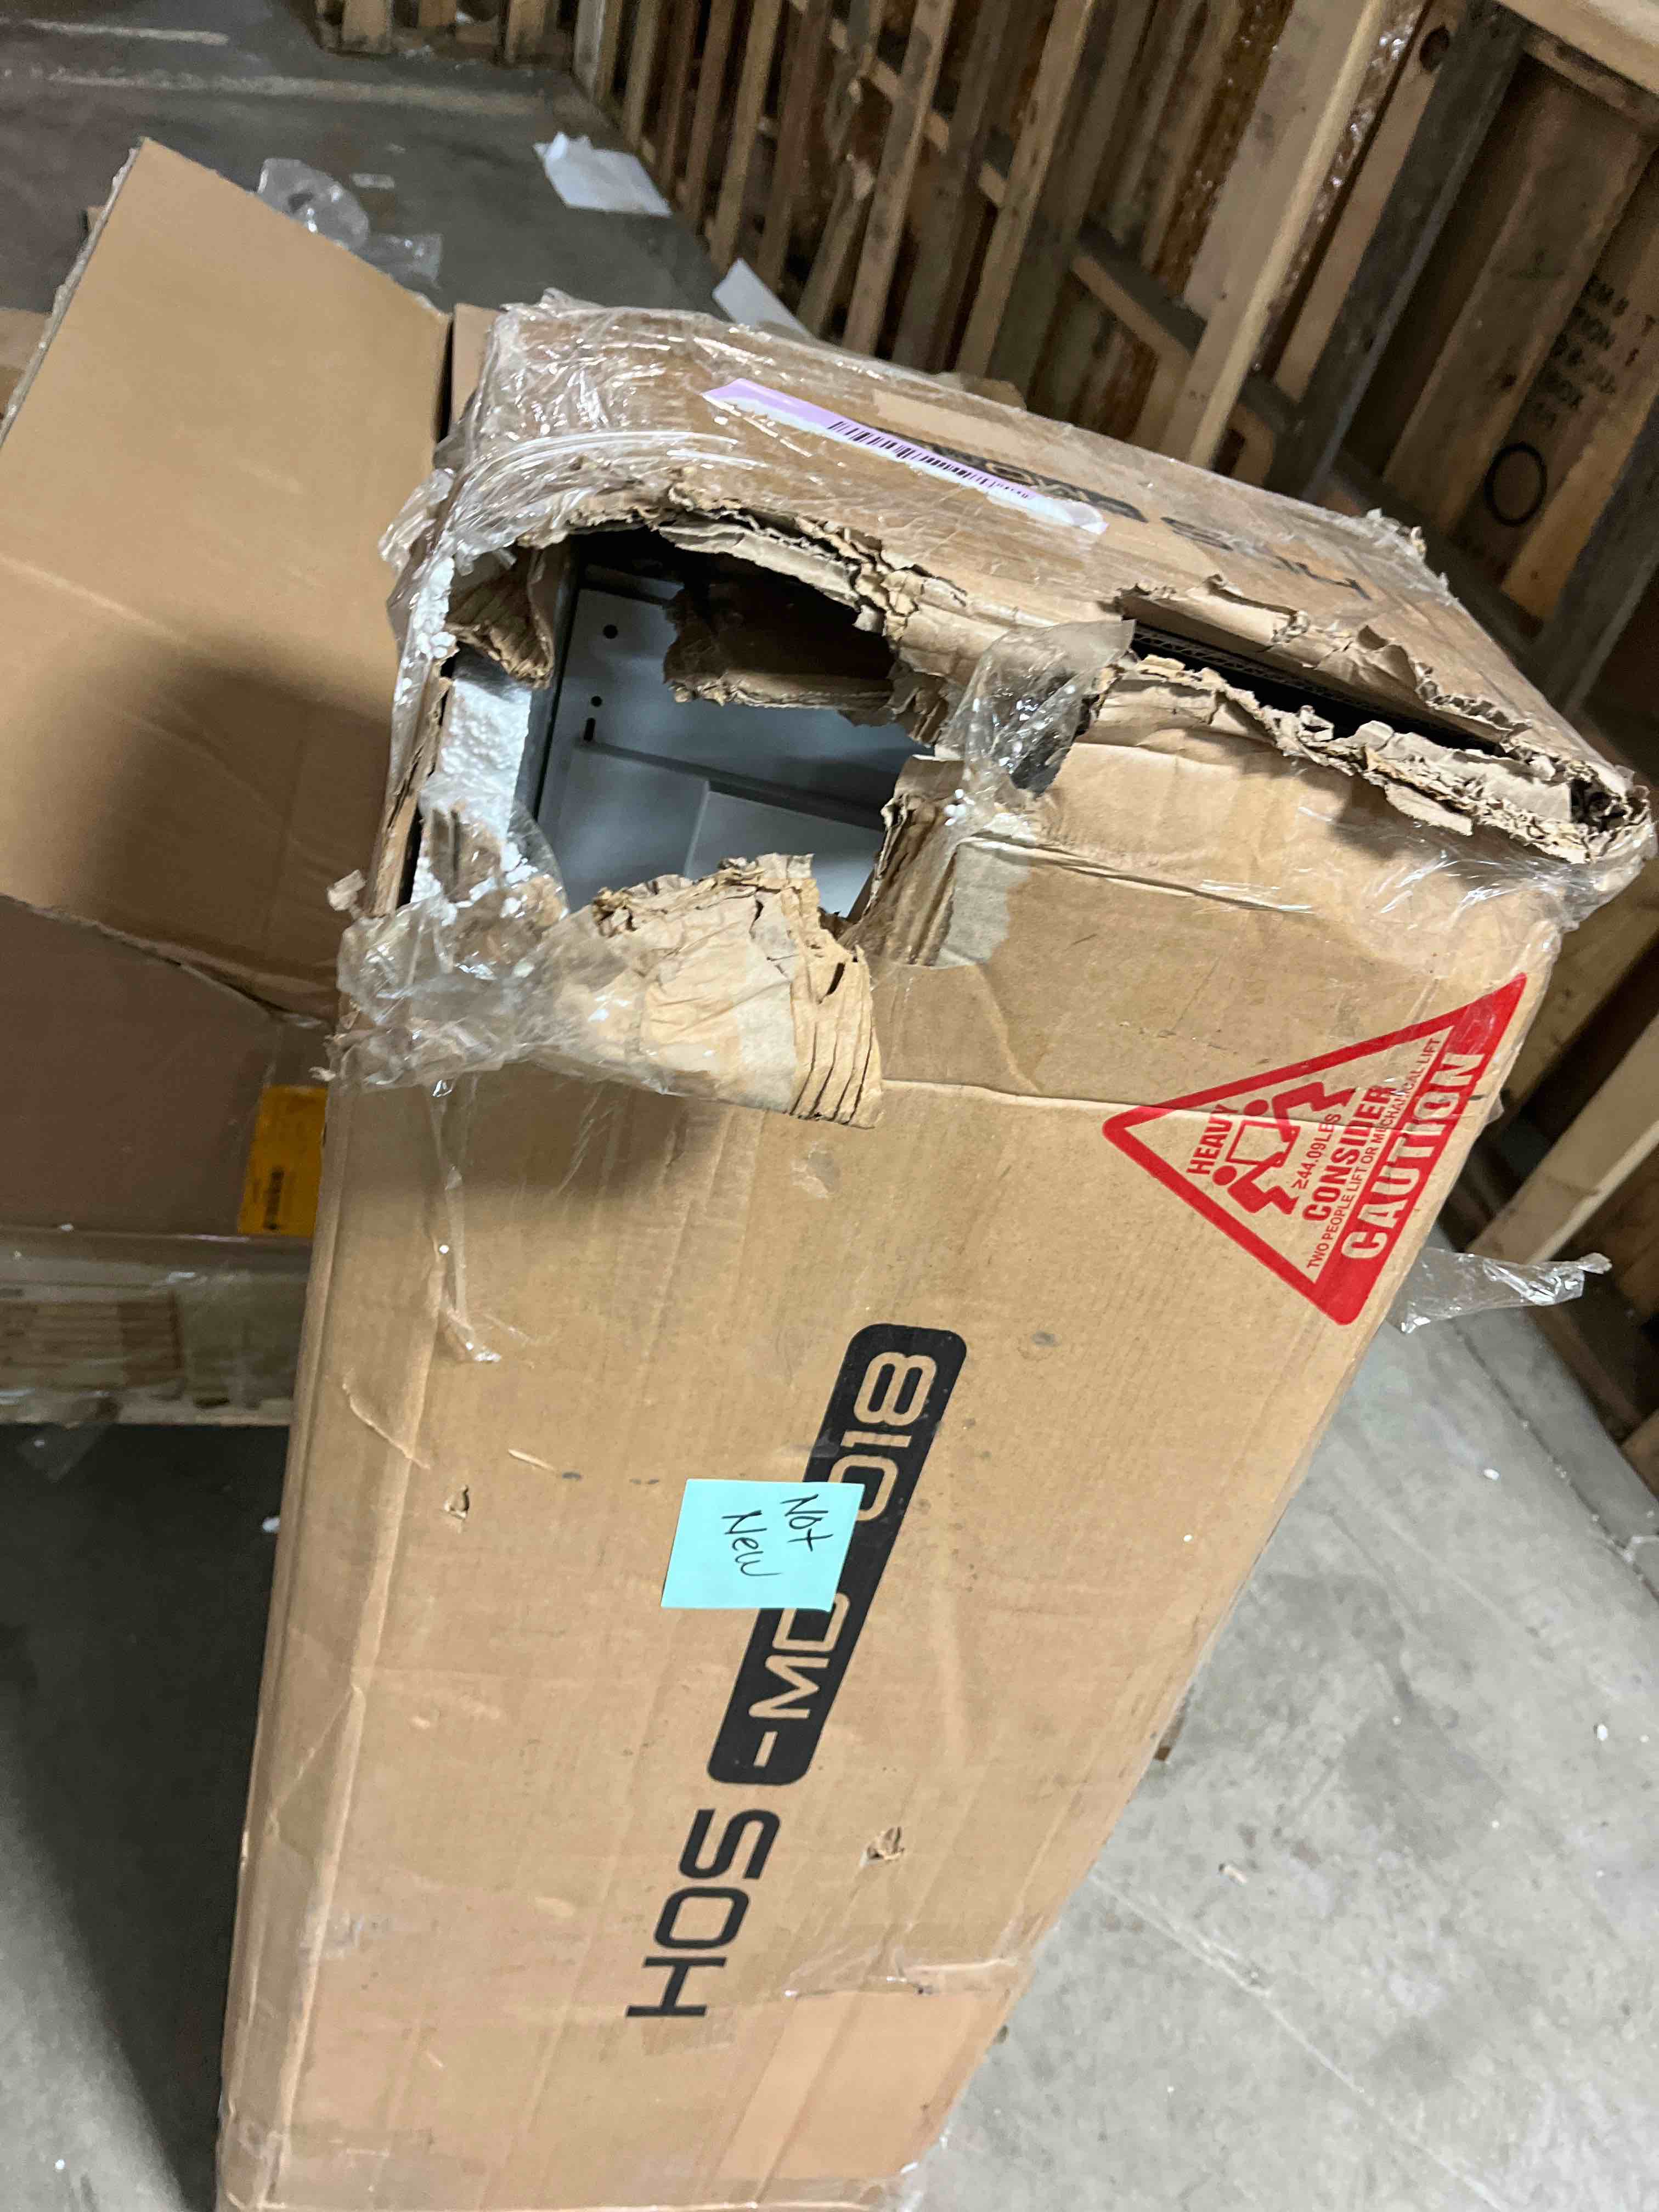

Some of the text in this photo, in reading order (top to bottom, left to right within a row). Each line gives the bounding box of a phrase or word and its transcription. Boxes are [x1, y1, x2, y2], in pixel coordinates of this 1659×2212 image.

[1186, 1104, 1238, 1175] HEAVY
[1302, 1085, 1396, 1221] CONSIDER
[1307, 1243, 1330, 1268] TWO
[1322, 1194, 1353, 1240] PEOPLE
[1347, 1166, 1365, 1192] LIFT
[1361, 1147, 1379, 1164] OR
[1417, 1038, 1441, 1064] LIFT
[1341, 1053, 1485, 1259] CAUTION
[721, 1493, 834, 1577] Not New
[625, 1809, 781, 2018] HOS
